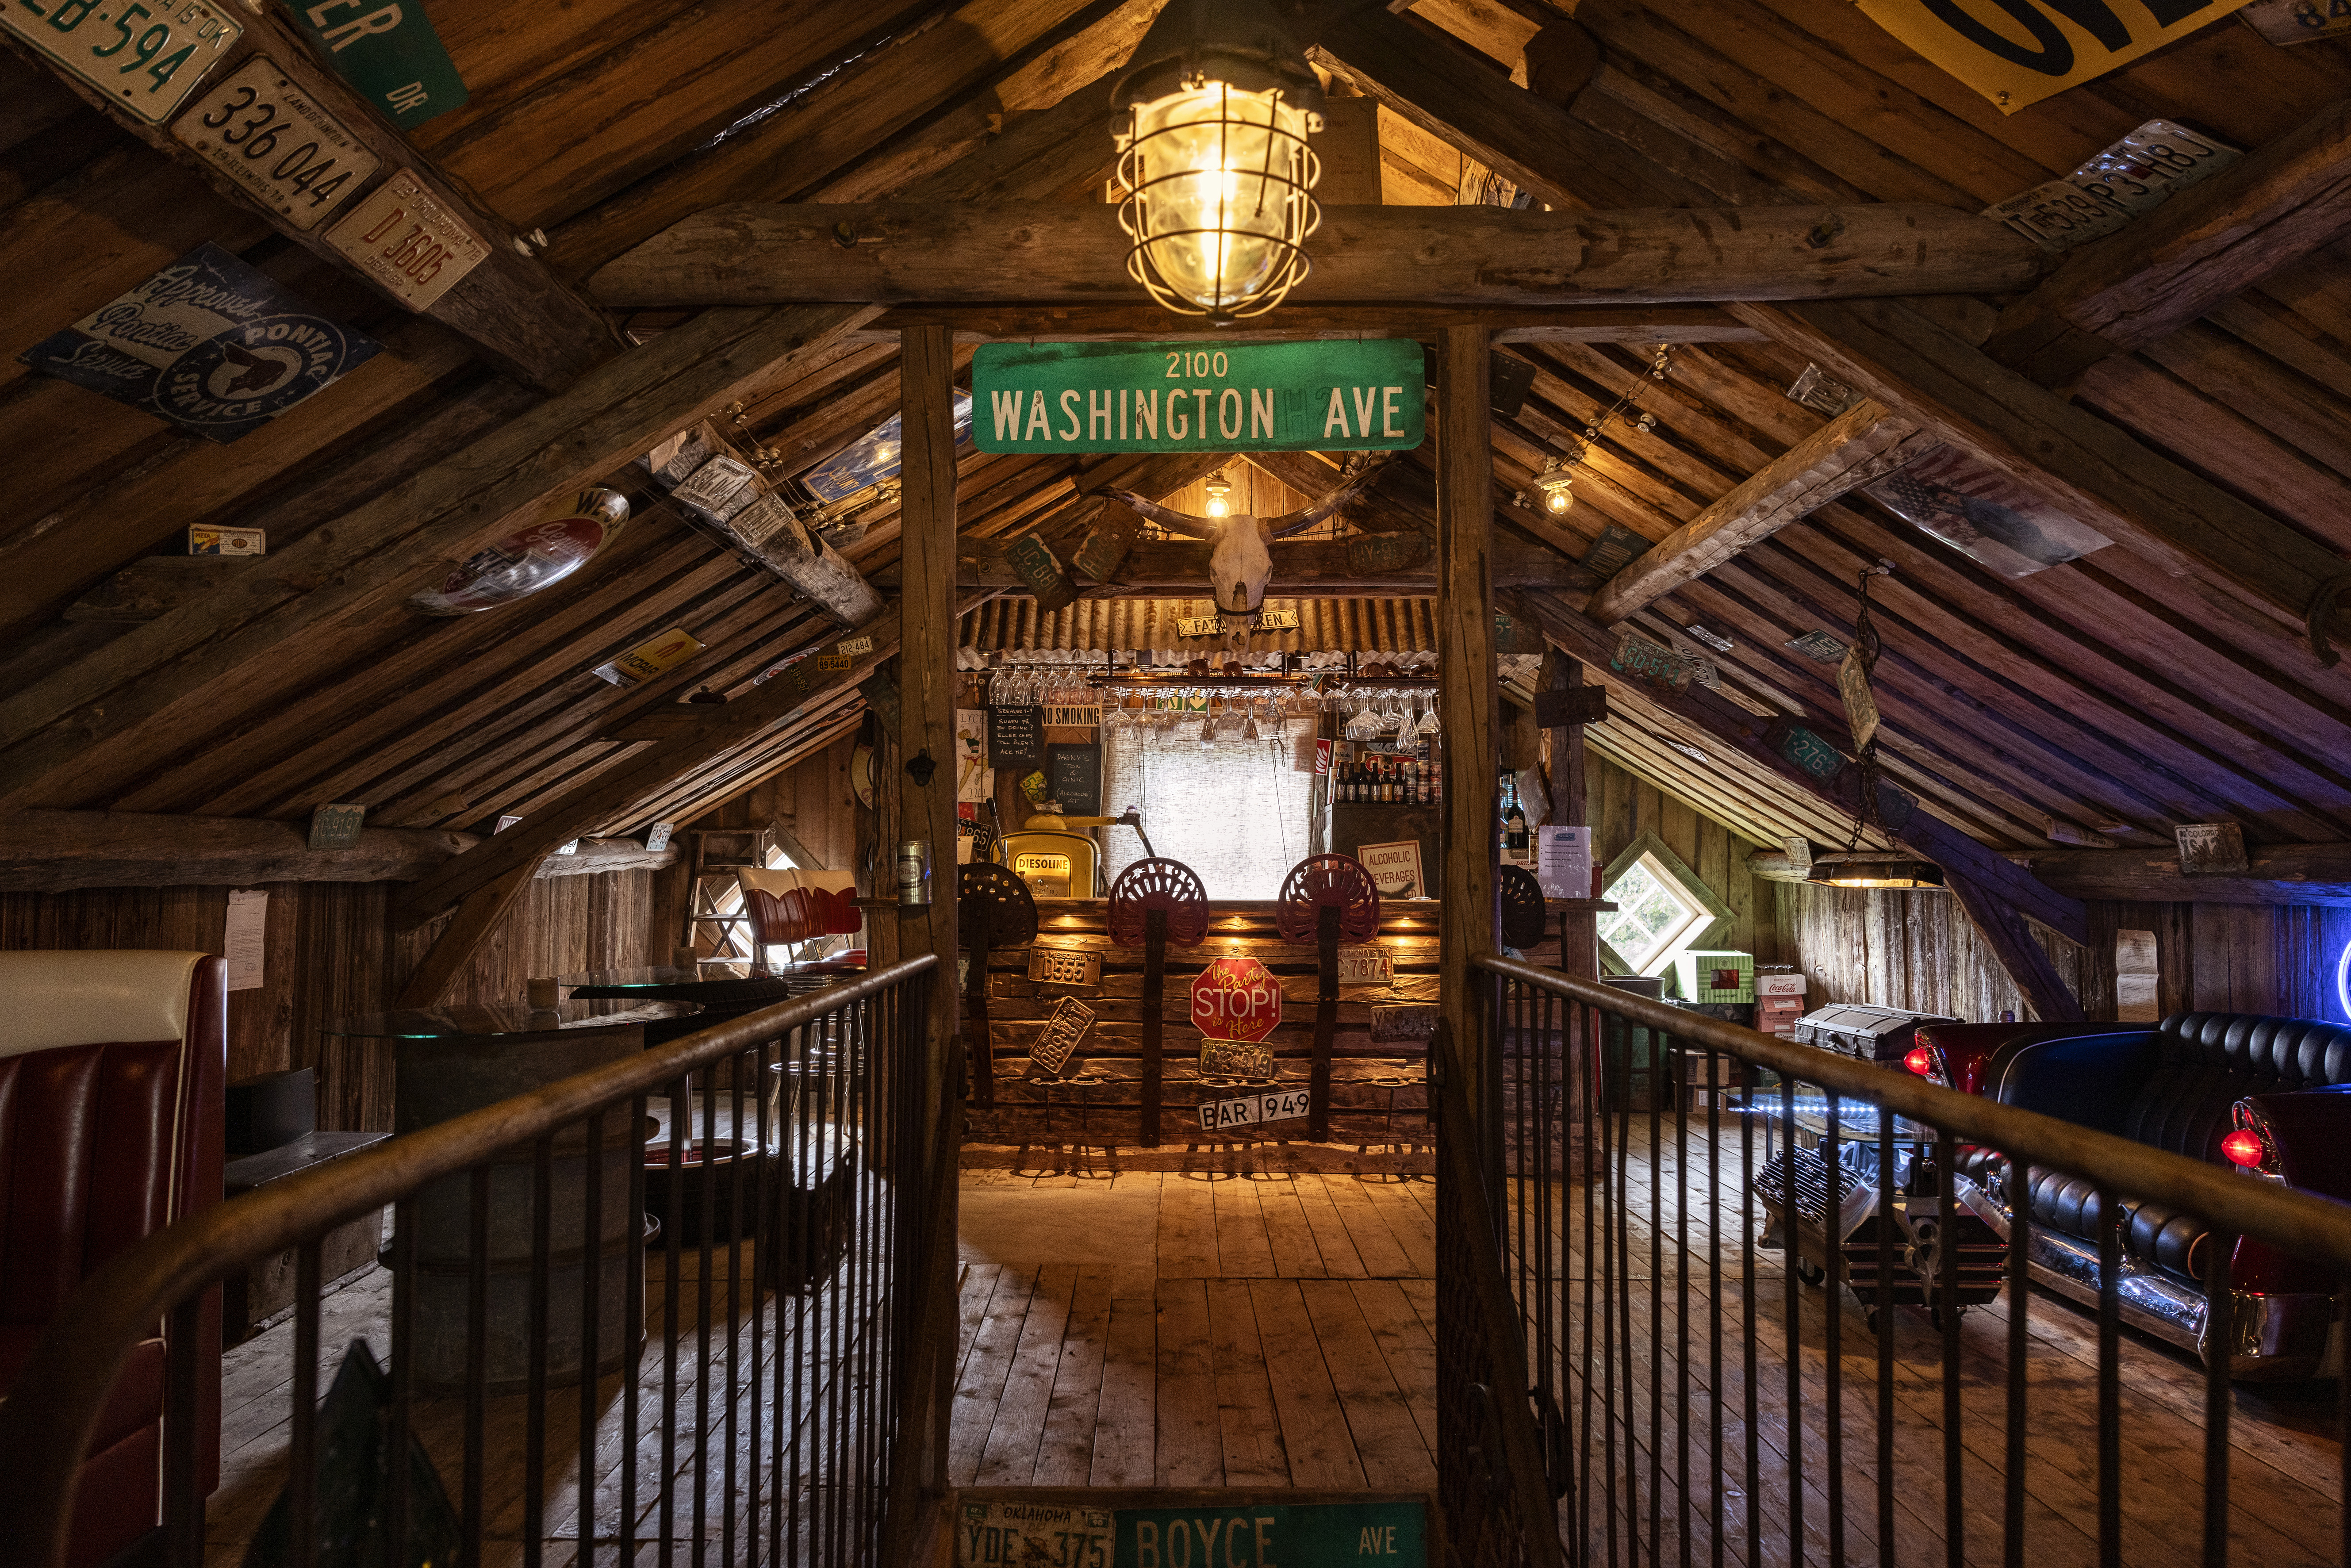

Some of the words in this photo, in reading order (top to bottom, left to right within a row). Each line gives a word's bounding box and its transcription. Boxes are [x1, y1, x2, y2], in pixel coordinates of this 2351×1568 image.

[386, 81, 428, 115] DR
[203, 87, 292, 159] 336
[273, 142, 353, 207] 044
[362, 208, 404, 243] D
[244, 322, 333, 381] PONTIAC
[1166, 351, 1229, 378] 2100
[170, 372, 262, 418] SERVICE
[991, 387, 1275, 441] WASHINGTON
[1324, 386, 1406, 439] AVE
[620, 653, 660, 677] MOPAR
[1042, 707, 1053, 724] NO
[1055, 707, 1100, 725] SMOKING
[1019, 859, 1068, 869] DIESOLINE
[1369, 851, 1411, 866] ALCOHOLIC
[1049, 951, 1083, 961] MISSOURI
[1043, 957, 1085, 982] D555
[1207, 965, 1230, 980] The
[1218, 966, 1269, 994] Party
[1769, 983, 1796, 993] Coca-Cola
[1196, 987, 1277, 1017] STOP!
[1212, 1017, 1223, 1027] is
[1225, 1016, 1264, 1039] Here
[1203, 1103, 1248, 1127] BAR
[1003, 1507, 1072, 1523] OKLAHOMA
[1136, 1517, 1277, 1568] BOYCE
[1358, 1526, 1398, 1556] AVE
